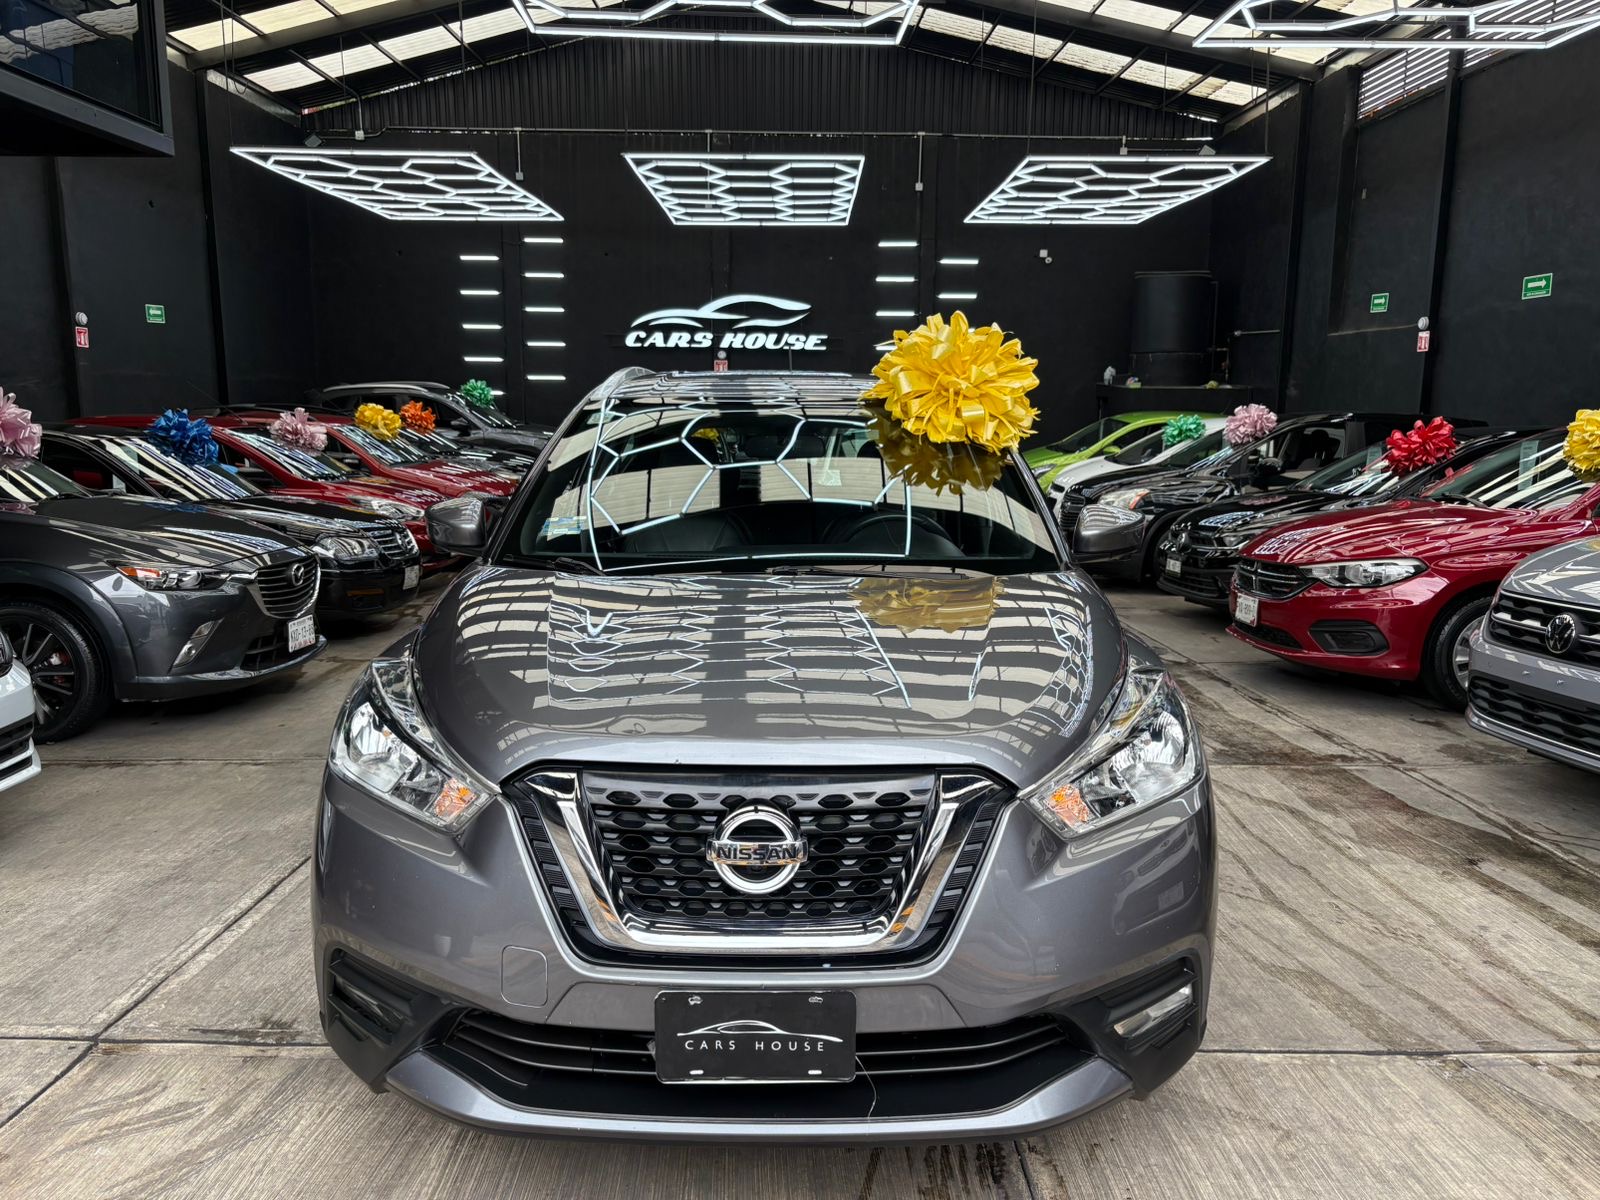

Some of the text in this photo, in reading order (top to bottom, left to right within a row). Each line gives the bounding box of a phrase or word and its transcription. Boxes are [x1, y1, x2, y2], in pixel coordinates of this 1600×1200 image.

[625, 330, 828, 350] CARS HOUSE
[716, 846, 797, 861] NISSAN
[684, 1040, 824, 1052] CARS HOUSE
